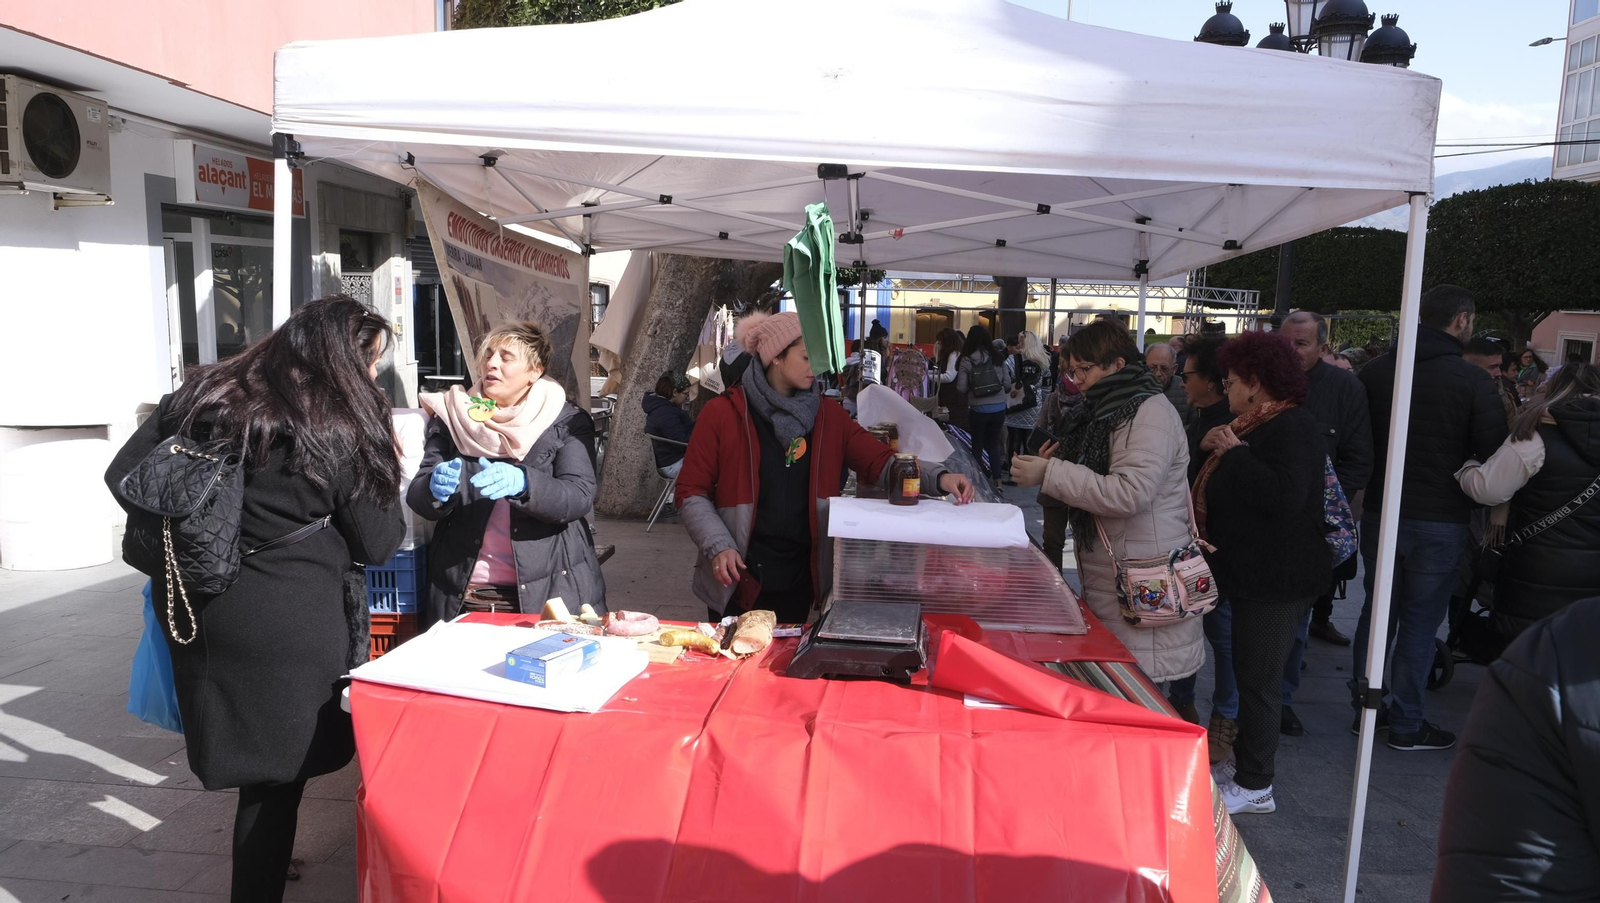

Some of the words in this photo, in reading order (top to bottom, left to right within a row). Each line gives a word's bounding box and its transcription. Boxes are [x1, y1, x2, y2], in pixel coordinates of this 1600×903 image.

[212, 157, 233, 168] HELADOS
[198, 163, 247, 195] alaçant
[253, 181, 264, 198] EL
[447, 211, 495, 254] EMBUTIDOS
[490, 234, 525, 265] CASEROS
[1573, 483, 1600, 504] LOLA
